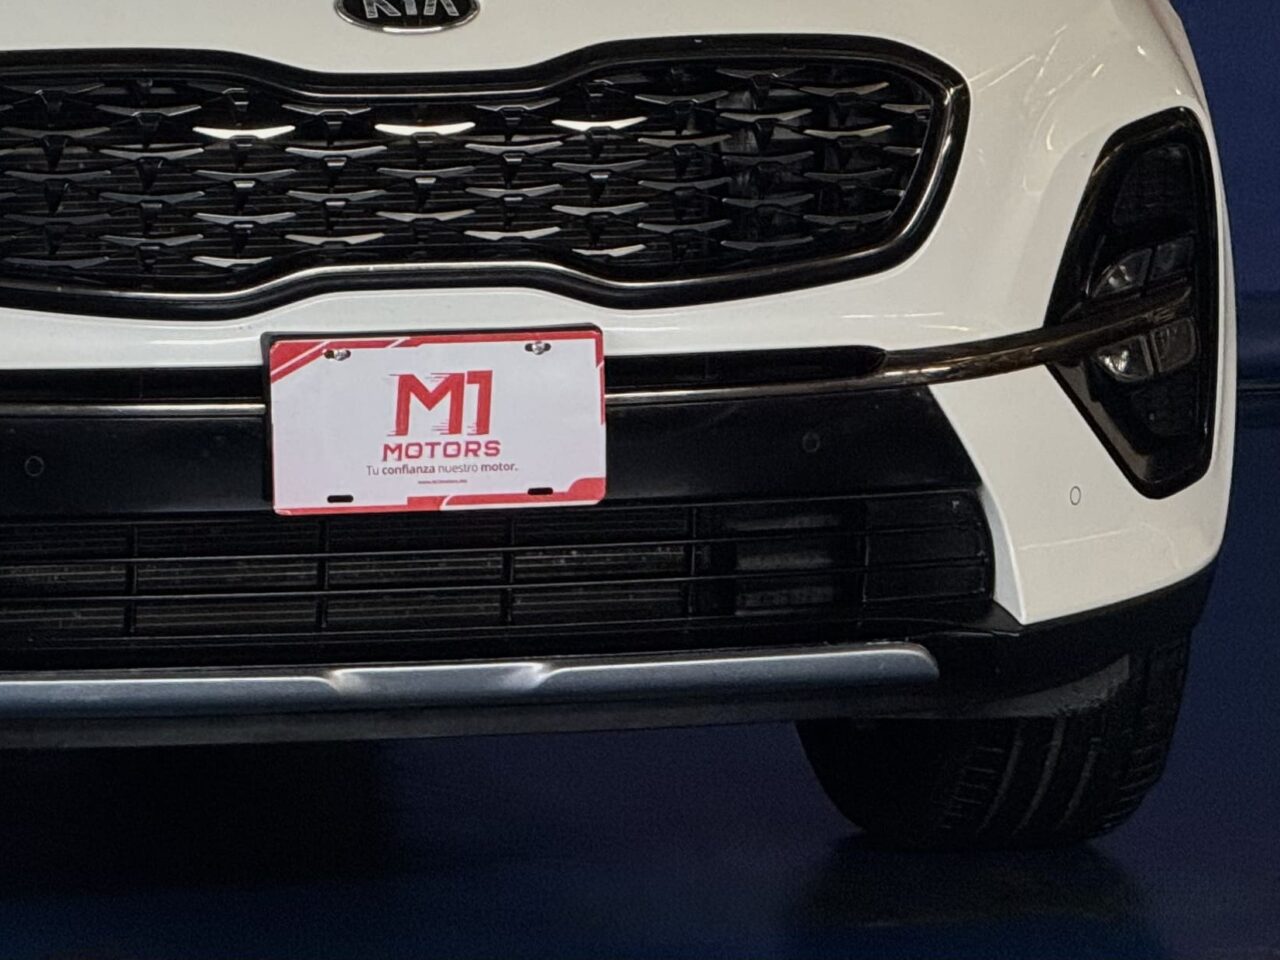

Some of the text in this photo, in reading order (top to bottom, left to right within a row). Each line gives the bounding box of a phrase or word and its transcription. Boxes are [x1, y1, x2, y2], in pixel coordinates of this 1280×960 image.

[387, 370, 493, 437] M1
[382, 440, 501, 462] MOTORS
[366, 461, 519, 476] Tu confianza nuestro motor.
